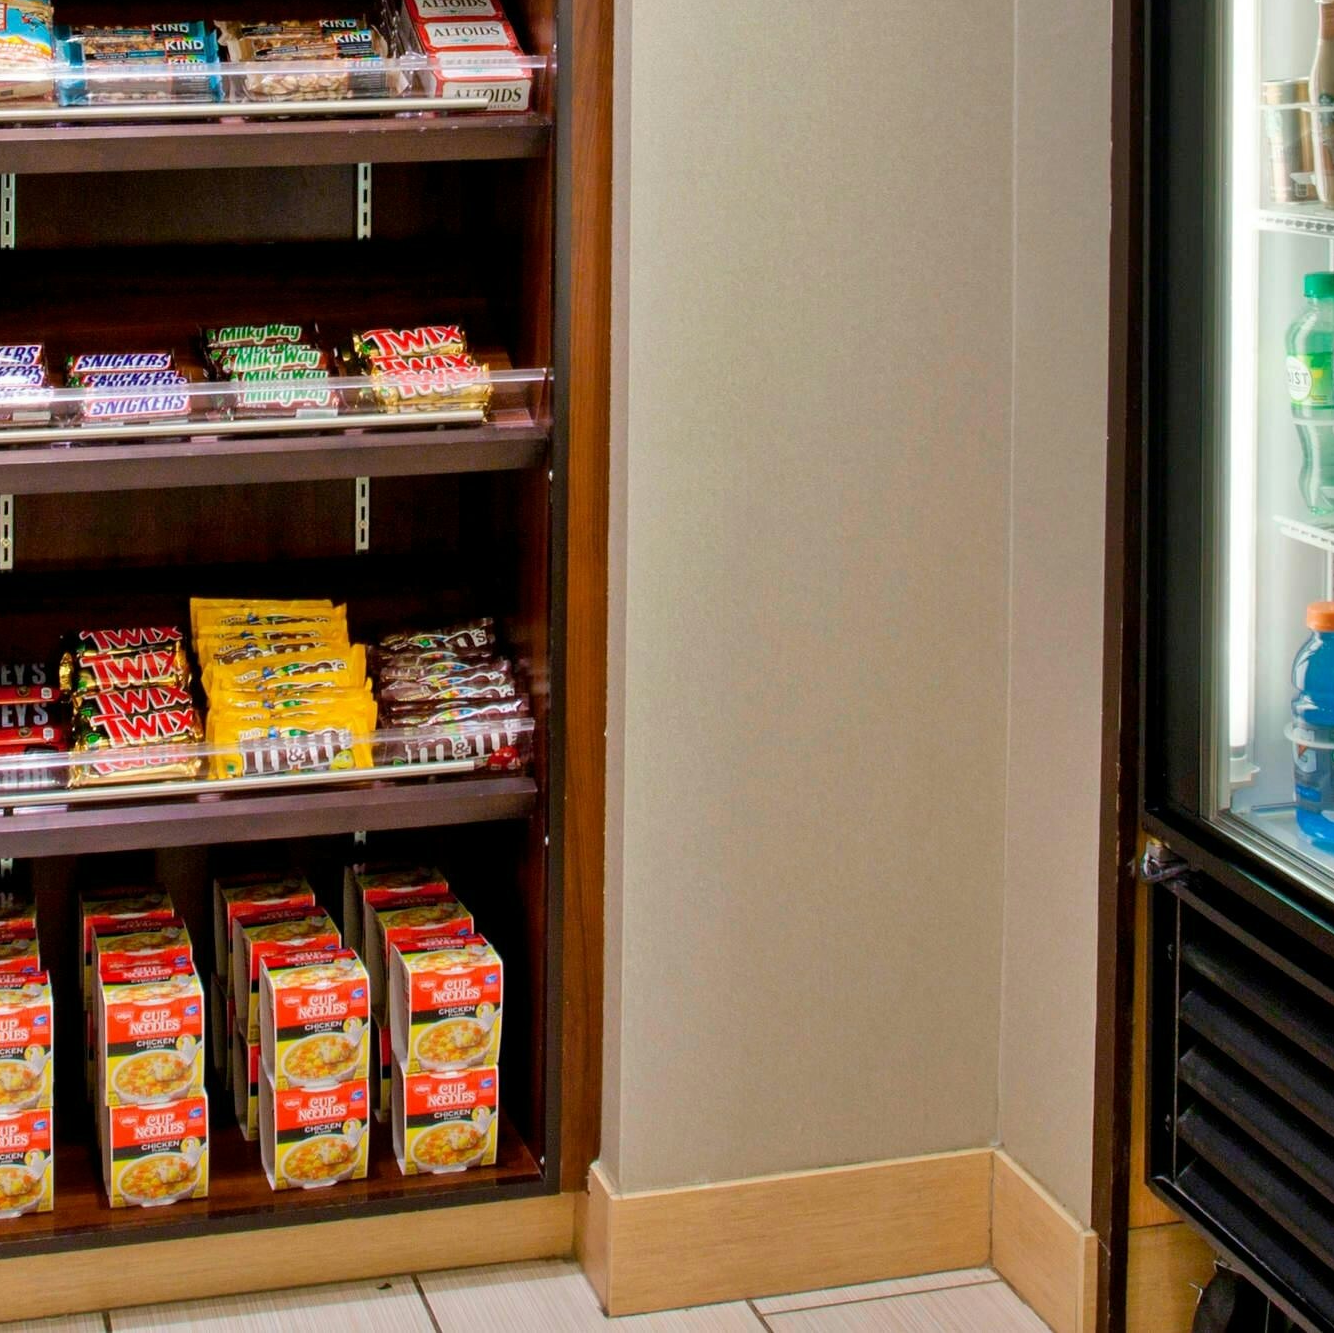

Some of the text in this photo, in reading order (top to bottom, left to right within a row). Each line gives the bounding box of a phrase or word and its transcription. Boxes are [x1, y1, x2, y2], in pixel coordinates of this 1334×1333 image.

[434, 24, 500, 37] ALTOIDS
[334, 32, 371, 44] KIND
[166, 40, 204, 51] KIND
[364, 325, 462, 357] TWIX
[77, 354, 169, 368] SNICKERS
[92, 395, 188, 416] SNICKERS
[80, 626, 182, 653] TWIX
[81, 650, 177, 691] TWIX
[92, 708, 196, 747] TWIX
[308, 994, 337, 1008] CUP
[297, 1004, 347, 1019] NOODLES
[304, 1021, 343, 1031] CHICKEN
